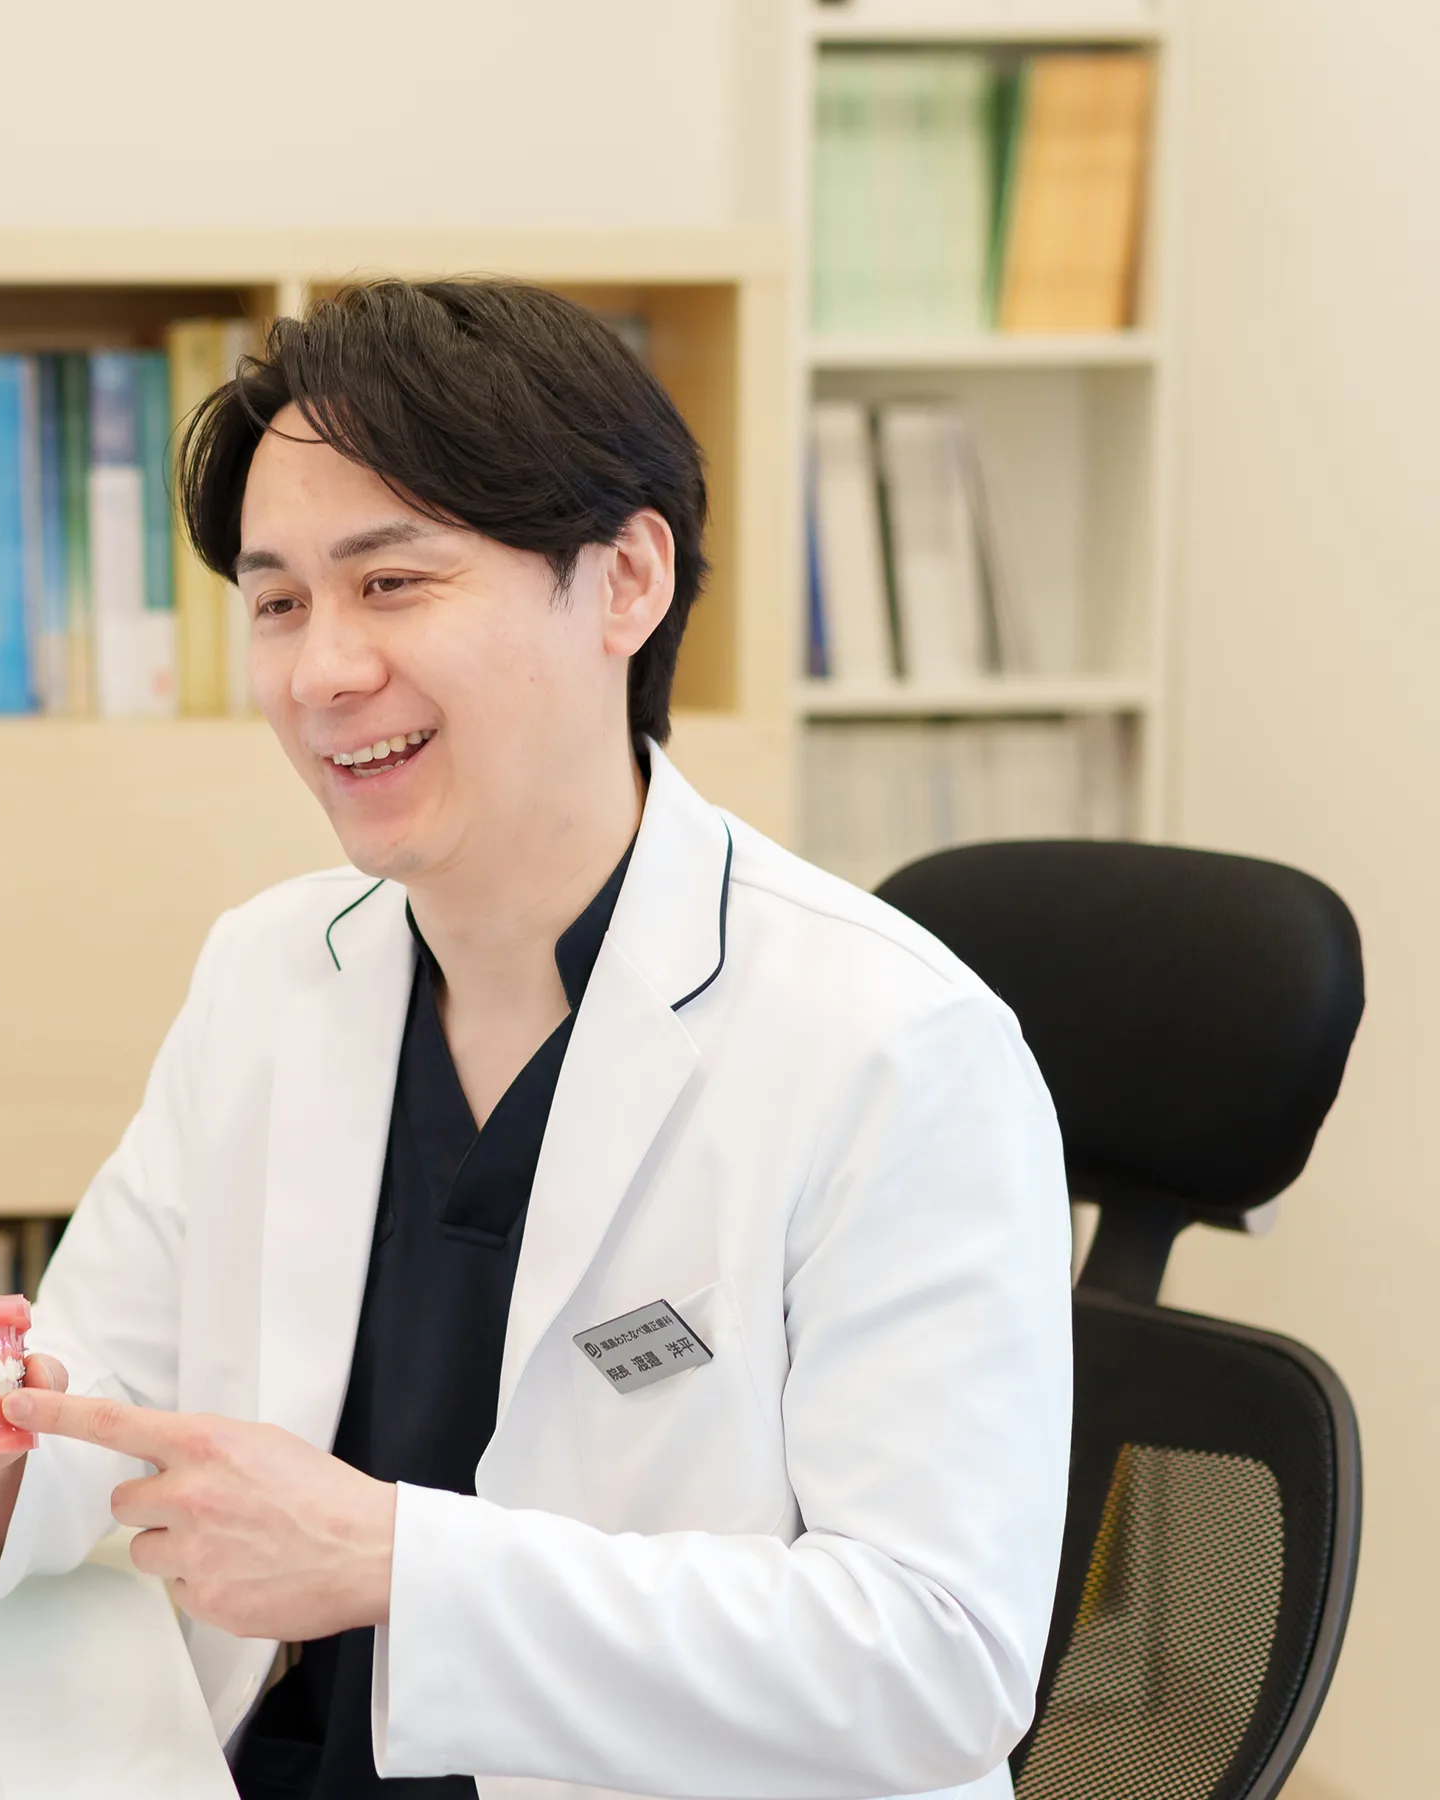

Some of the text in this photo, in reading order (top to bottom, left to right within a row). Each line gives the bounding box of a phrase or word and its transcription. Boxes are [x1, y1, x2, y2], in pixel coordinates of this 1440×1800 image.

[600, 1315, 674, 1351] 福島わたなべ矯正歯科
[606, 1364, 631, 1381] 院長
[665, 1337, 694, 1359] 洋平
